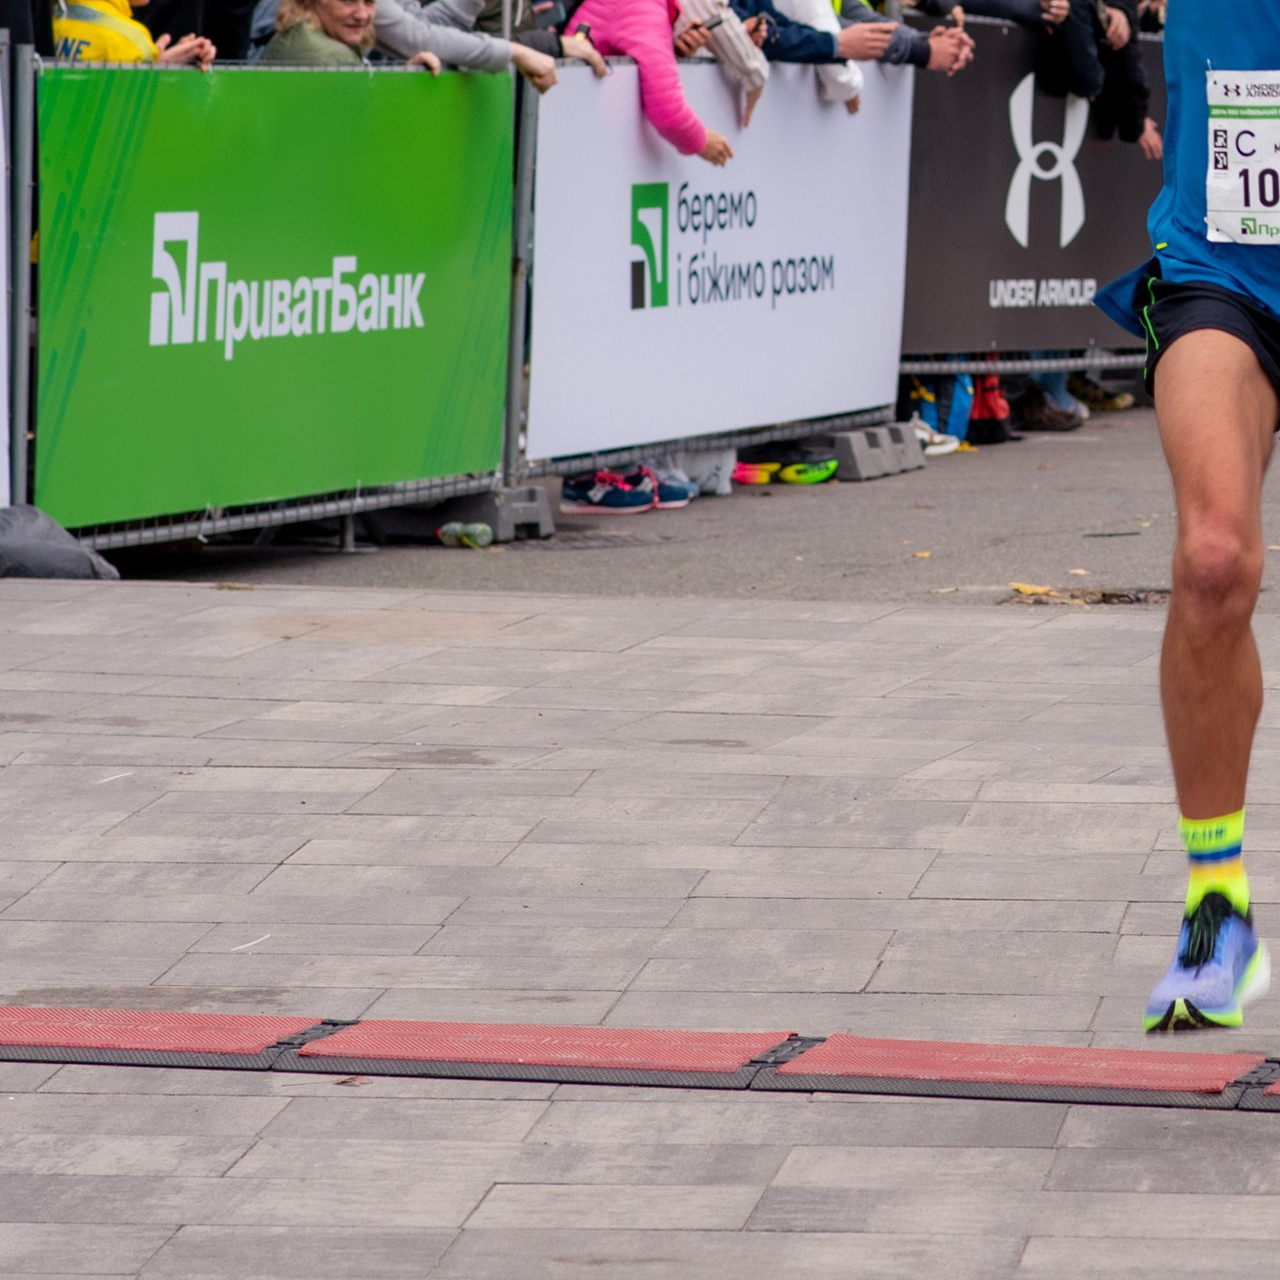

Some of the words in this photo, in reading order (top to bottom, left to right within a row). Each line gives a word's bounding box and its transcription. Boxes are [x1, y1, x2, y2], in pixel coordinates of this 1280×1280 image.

[676, 181, 758, 245] беремо
[197, 255, 426, 361] ПриватБанк
[687, 251, 766, 307] біжимо
[771, 253, 835, 310] разом
[989, 278, 1036, 308] UNDER
[1037, 278, 1097, 307] ARMOUR
